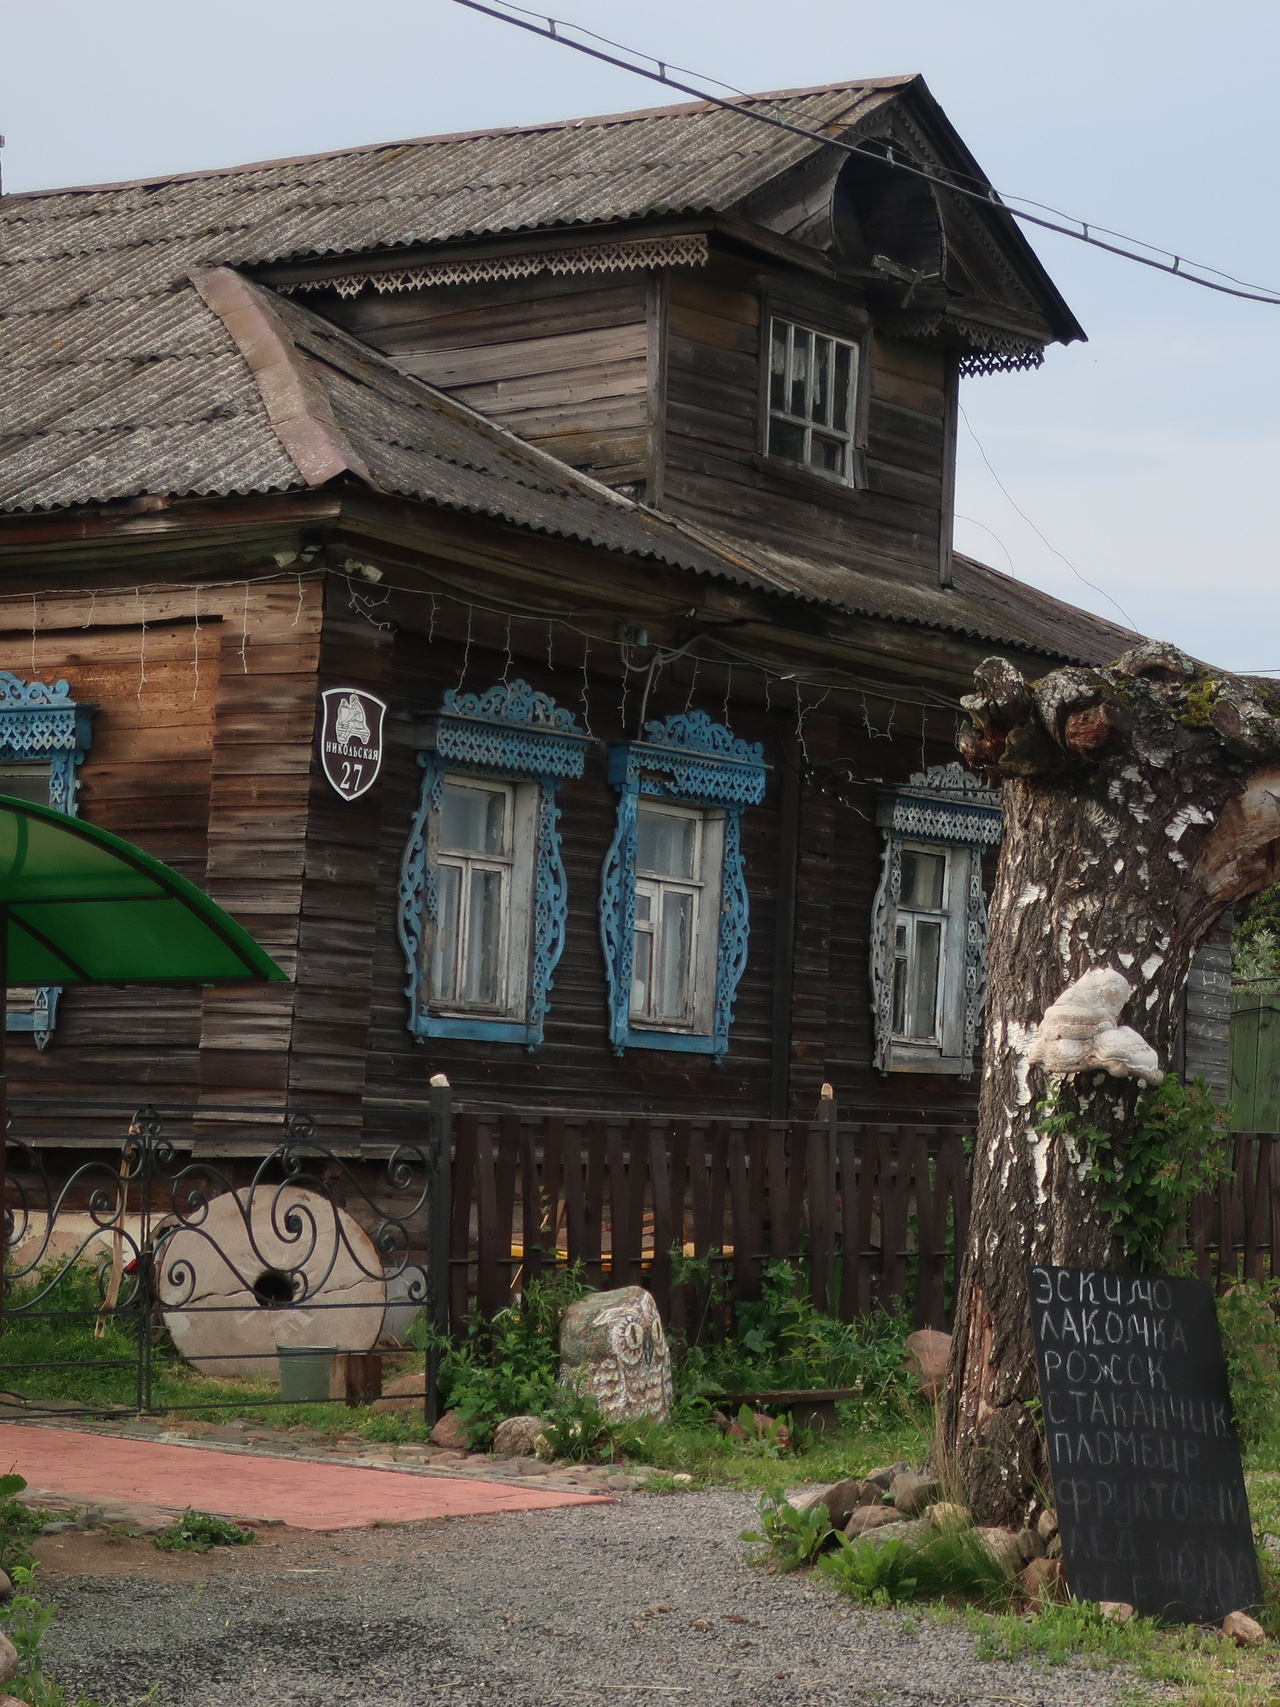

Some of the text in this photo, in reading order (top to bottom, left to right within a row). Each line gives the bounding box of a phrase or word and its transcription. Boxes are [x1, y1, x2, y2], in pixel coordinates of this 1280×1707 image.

[340, 761, 364, 792] 27
[1032, 1267, 1173, 1311] ЭСКИМО
[1040, 1307, 1189, 1353] ЛАКОМКА
[1044, 1349, 1172, 1391] РОЖОК
[1048, 1389, 1232, 1438] СТАКАНЧИК
[1054, 1431, 1200, 1476] ПЛОМБИР
